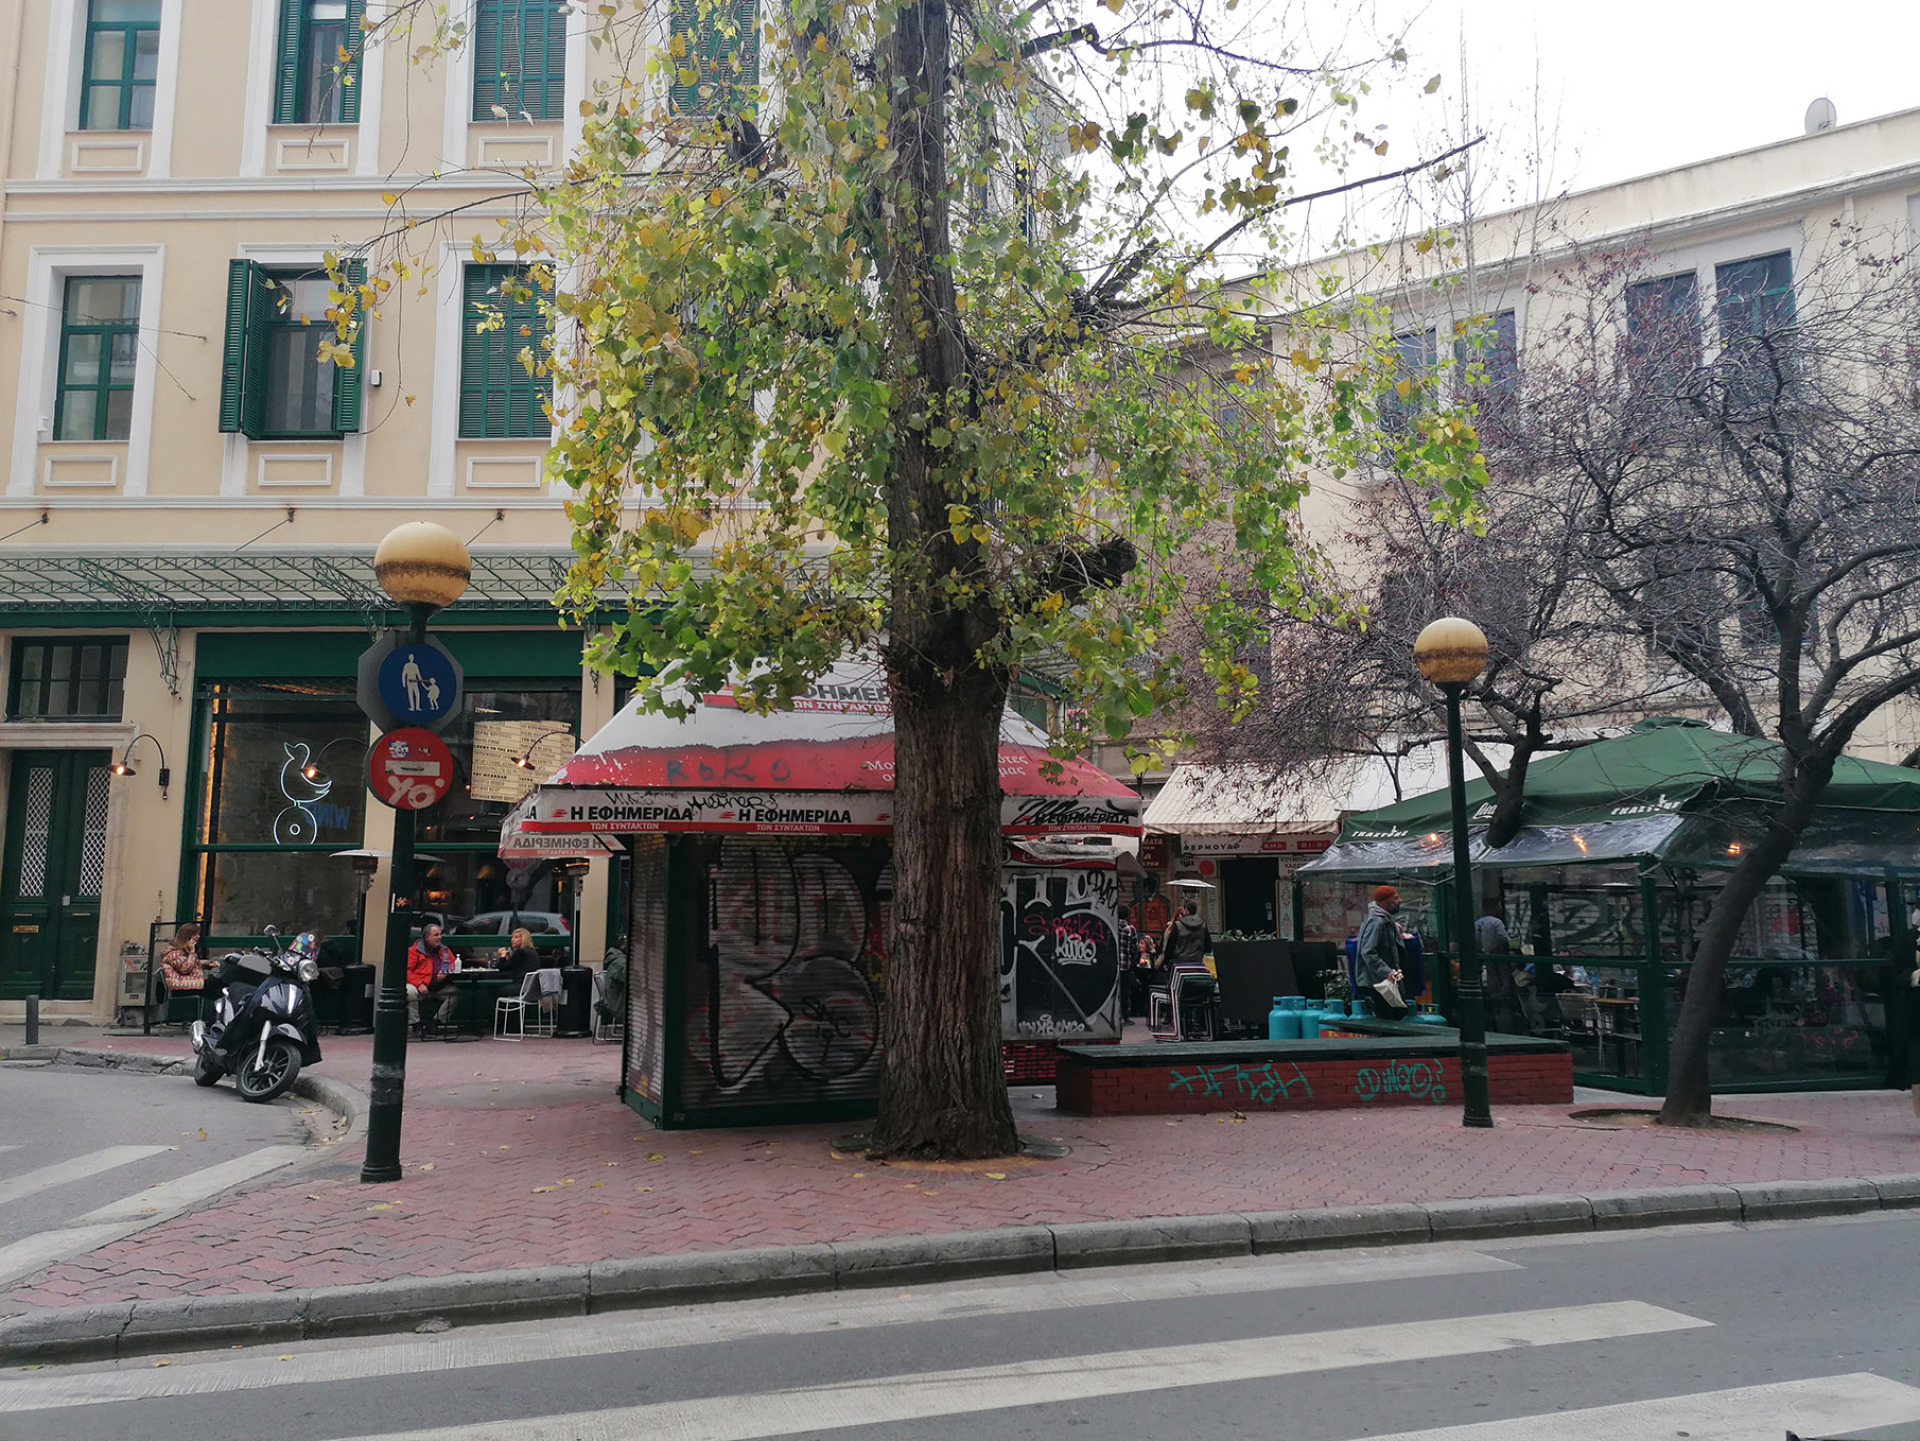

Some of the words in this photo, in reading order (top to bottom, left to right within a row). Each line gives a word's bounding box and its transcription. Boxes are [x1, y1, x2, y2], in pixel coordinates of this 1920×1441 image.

[571, 806, 583, 820] Η
[588, 805, 693, 821] ΕΦΗΜΕΡΙΔΑ
[738, 809, 751, 822] Η
[755, 809, 852, 823] ΕΦΗΜΕΡΙΔΑ
[591, 822, 608, 830] ΤΩΝ
[610, 822, 659, 830] ΣΥΝΤΑΚΤΩΝ
[774, 824, 820, 832] ΣΥΝΤΑΚΤΩΝ
